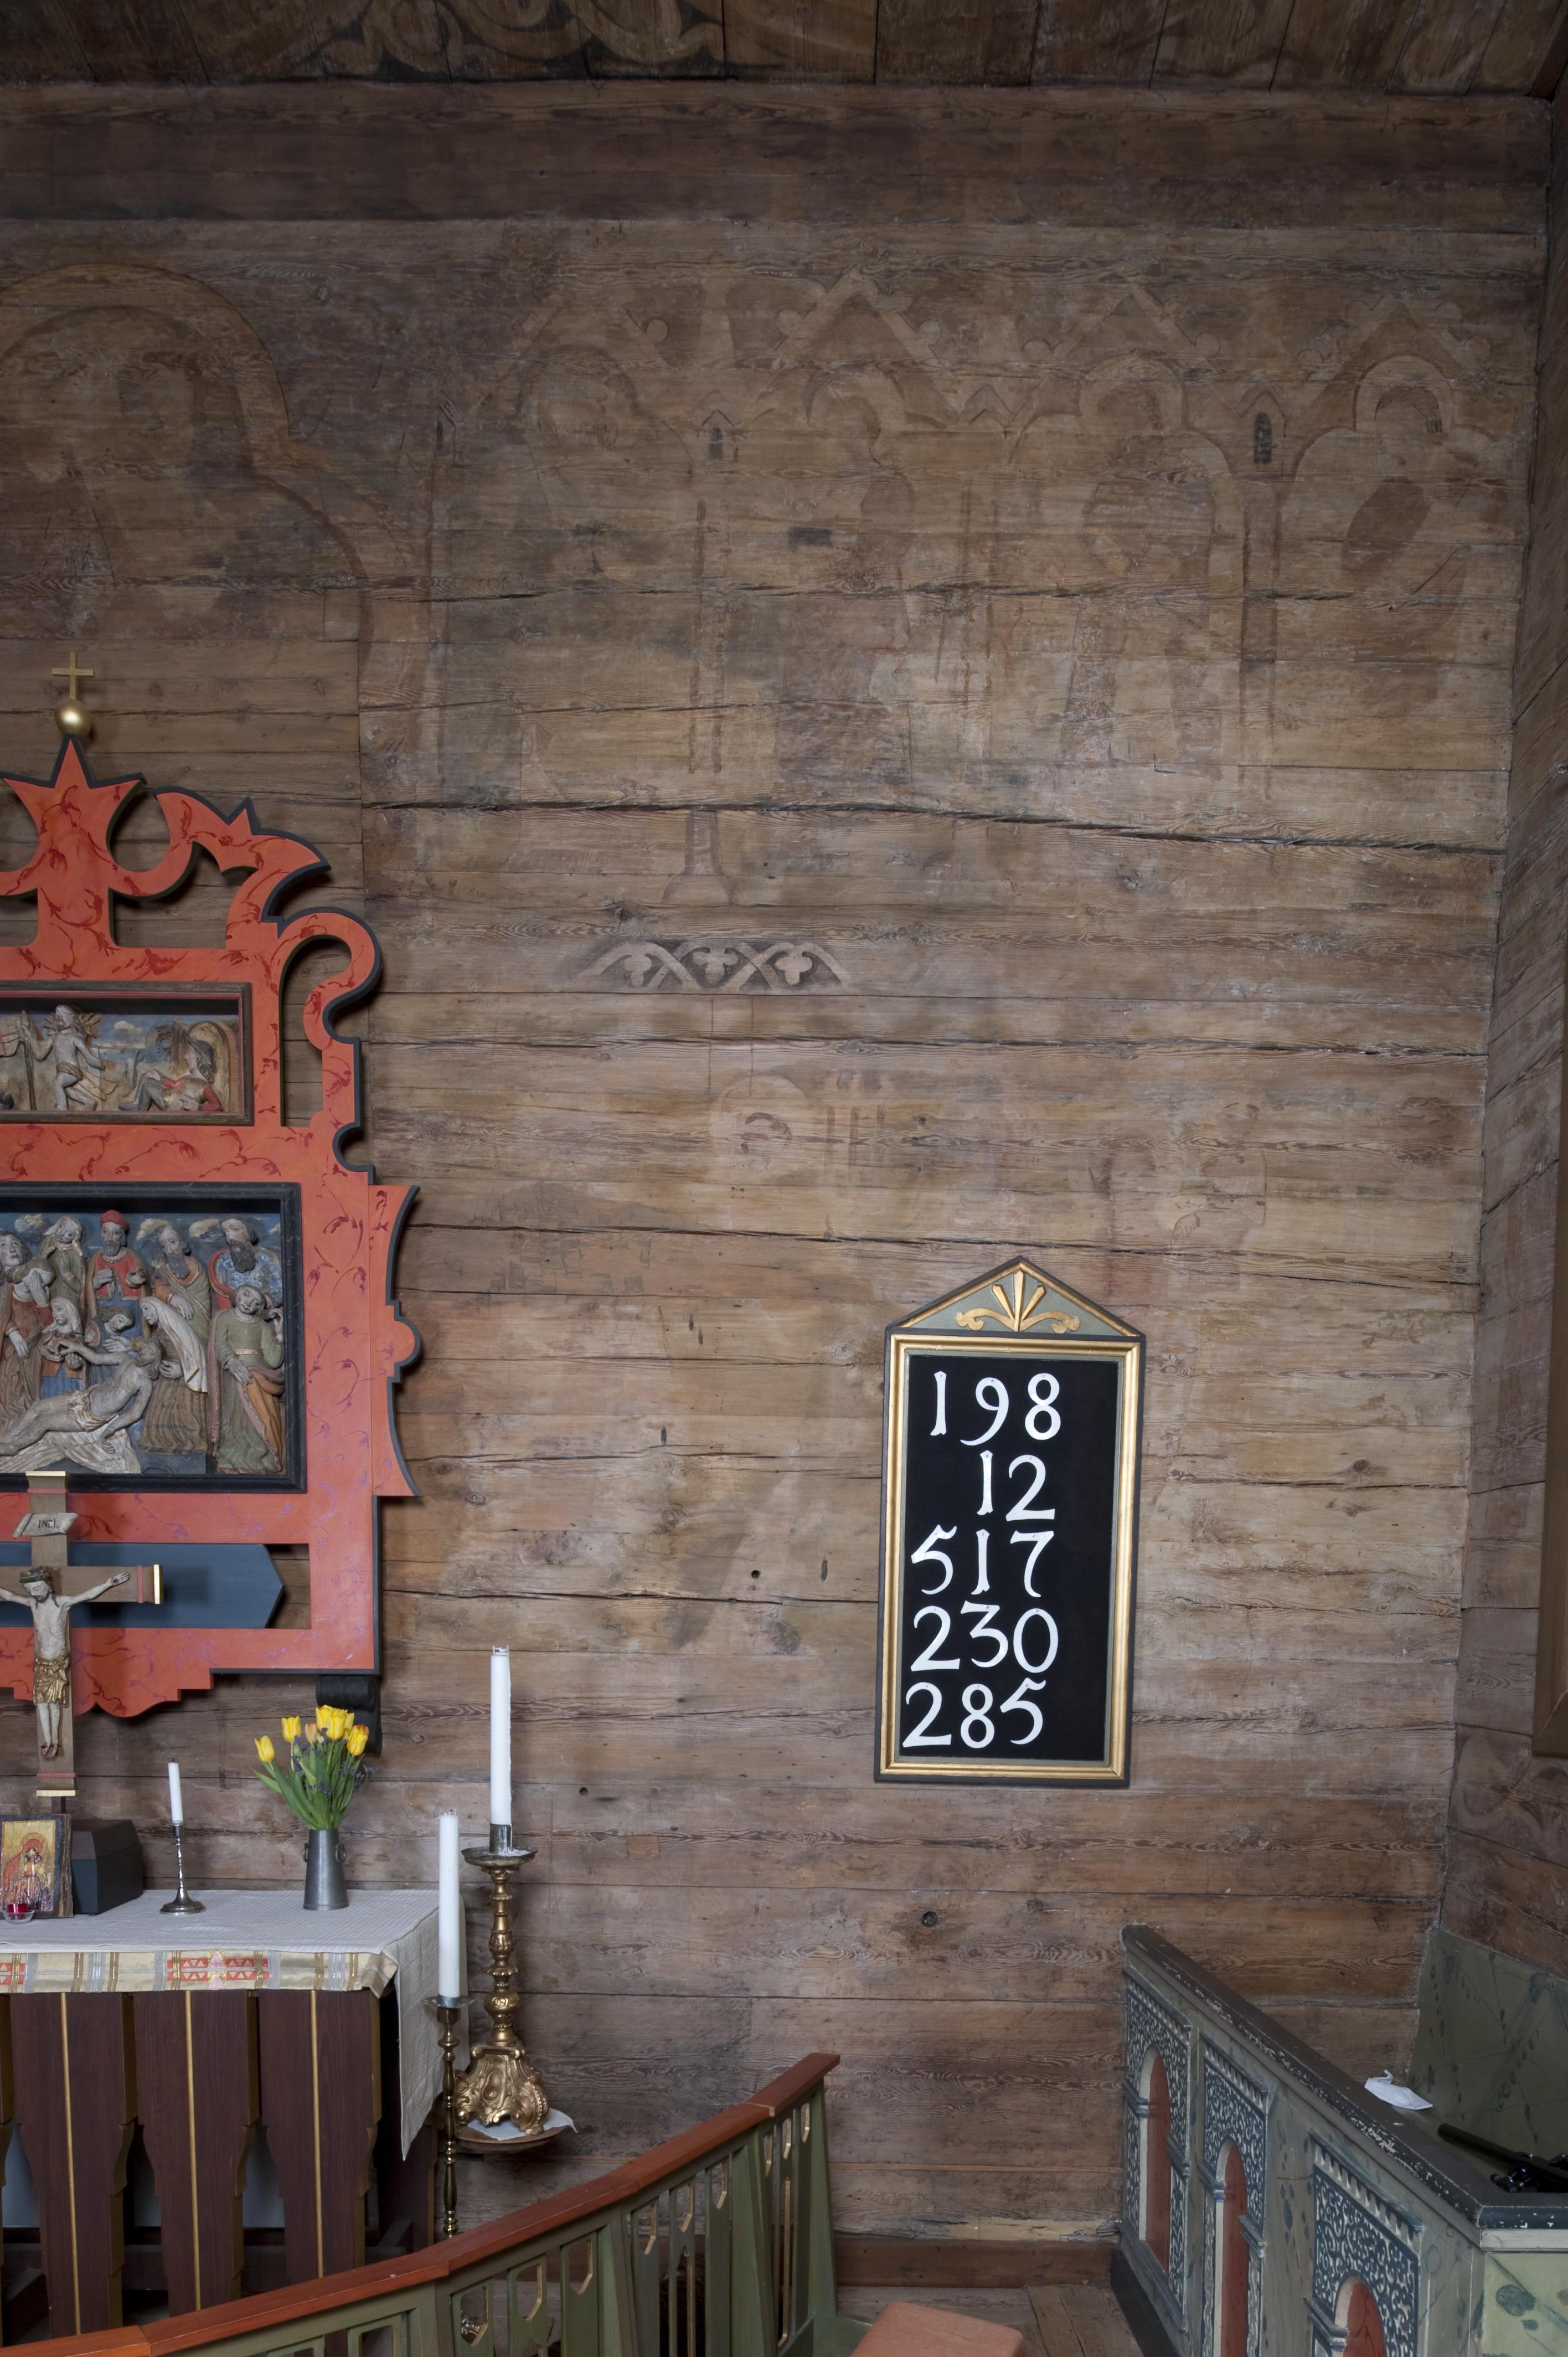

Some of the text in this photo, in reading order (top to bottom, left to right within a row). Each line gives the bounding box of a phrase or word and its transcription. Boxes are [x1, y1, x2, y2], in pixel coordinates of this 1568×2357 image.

[930, 1371, 1061, 1446] 198
[977, 1450, 1055, 1521] 12
[911, 1524, 1054, 1598] 517
[910, 1600, 1059, 1673] 230
[902, 1677, 1046, 1748] 285
